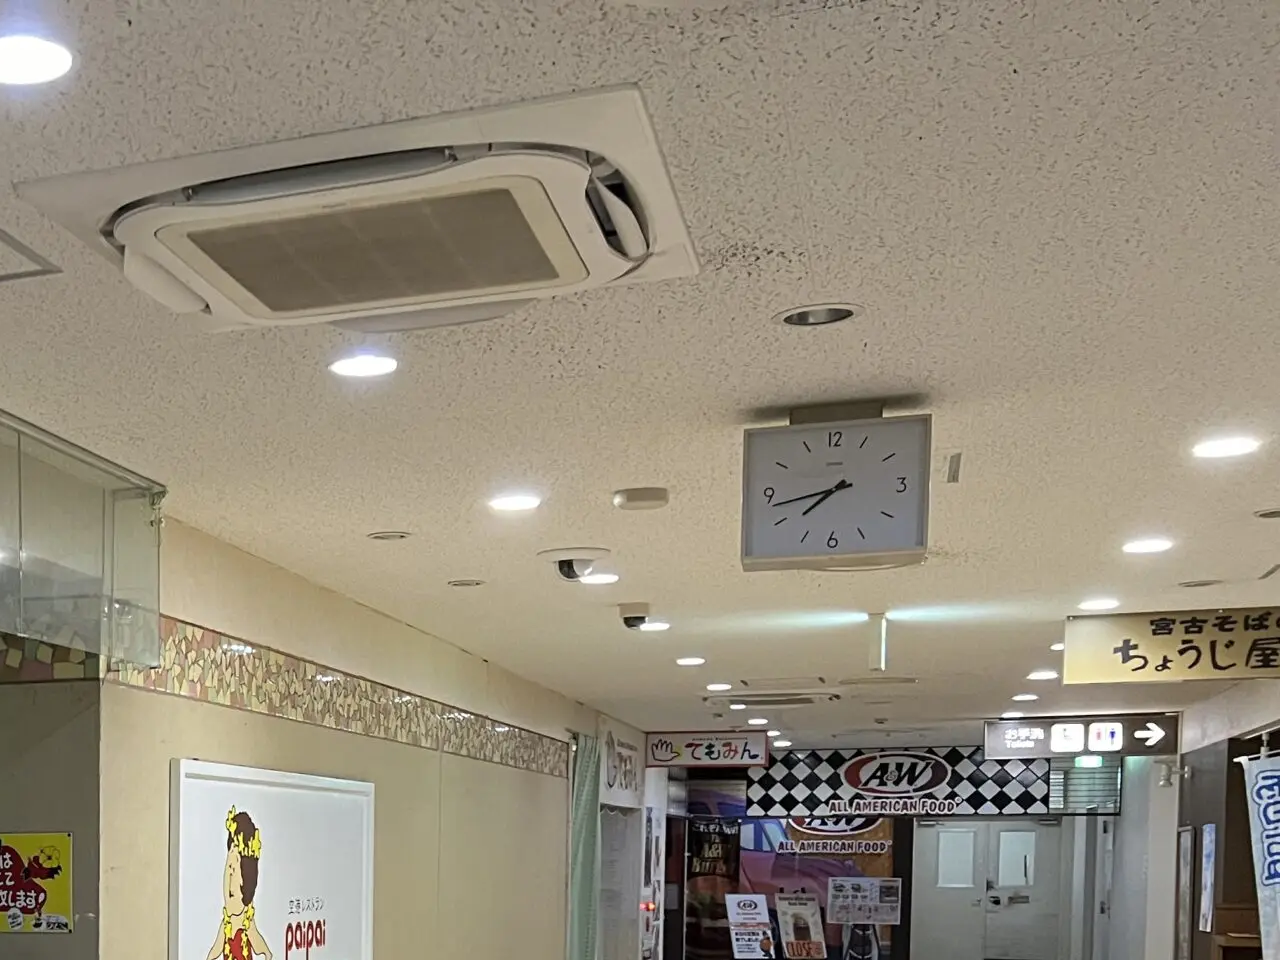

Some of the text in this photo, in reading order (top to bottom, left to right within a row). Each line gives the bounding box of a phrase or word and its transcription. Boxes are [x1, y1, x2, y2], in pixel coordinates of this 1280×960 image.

[827, 431, 843, 448] 12
[895, 476, 908, 493] 3
[763, 486, 775, 504] 9
[826, 531, 839, 549] 6
[1150, 611, 1280, 637] 宮古そば
[1113, 636, 1280, 673] ちょうじ屋
[684, 741, 760, 761] てもみん
[861, 761, 935, 788] A&W
[829, 800, 956, 813] ALL AMERICAN FOOD
[777, 840, 887, 853] ALL AMERICAN FOOD
[288, 896, 326, 915] 空港レストラン
